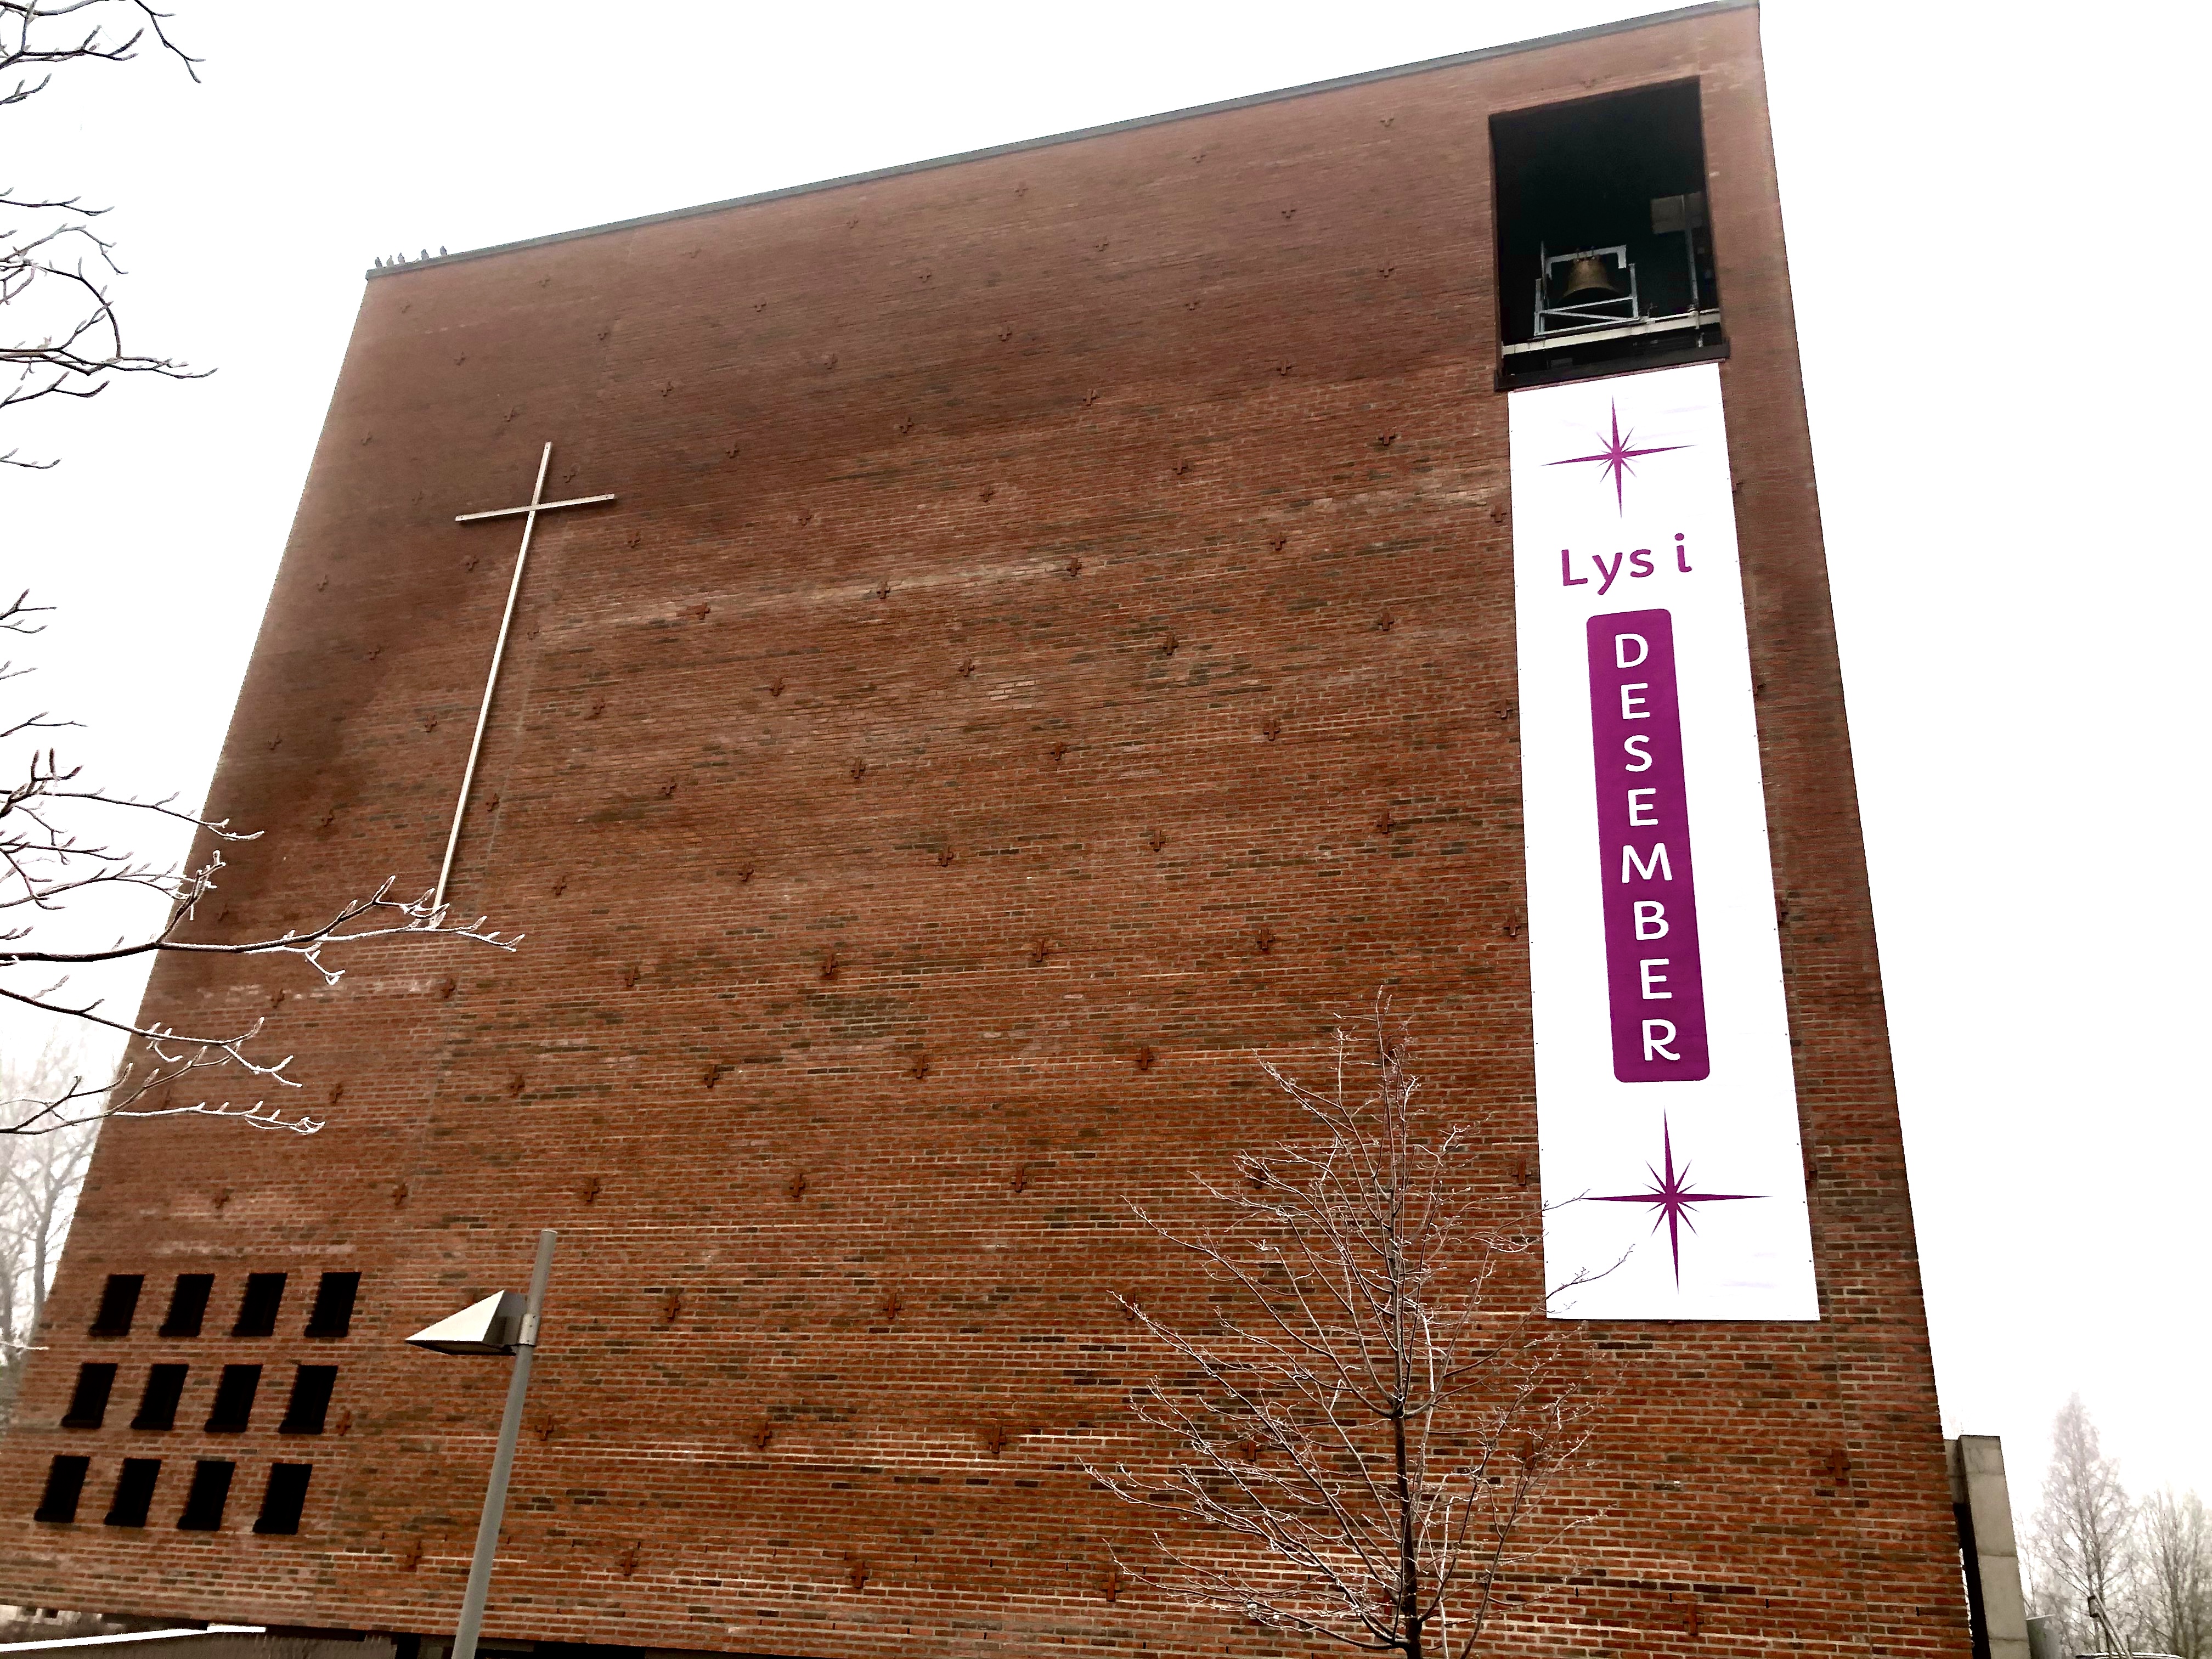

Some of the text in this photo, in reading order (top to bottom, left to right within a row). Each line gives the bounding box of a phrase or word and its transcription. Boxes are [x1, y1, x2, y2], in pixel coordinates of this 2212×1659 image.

[1561, 532, 1693, 596] Lys i
[1614, 632, 1681, 1062] DESEMBER
